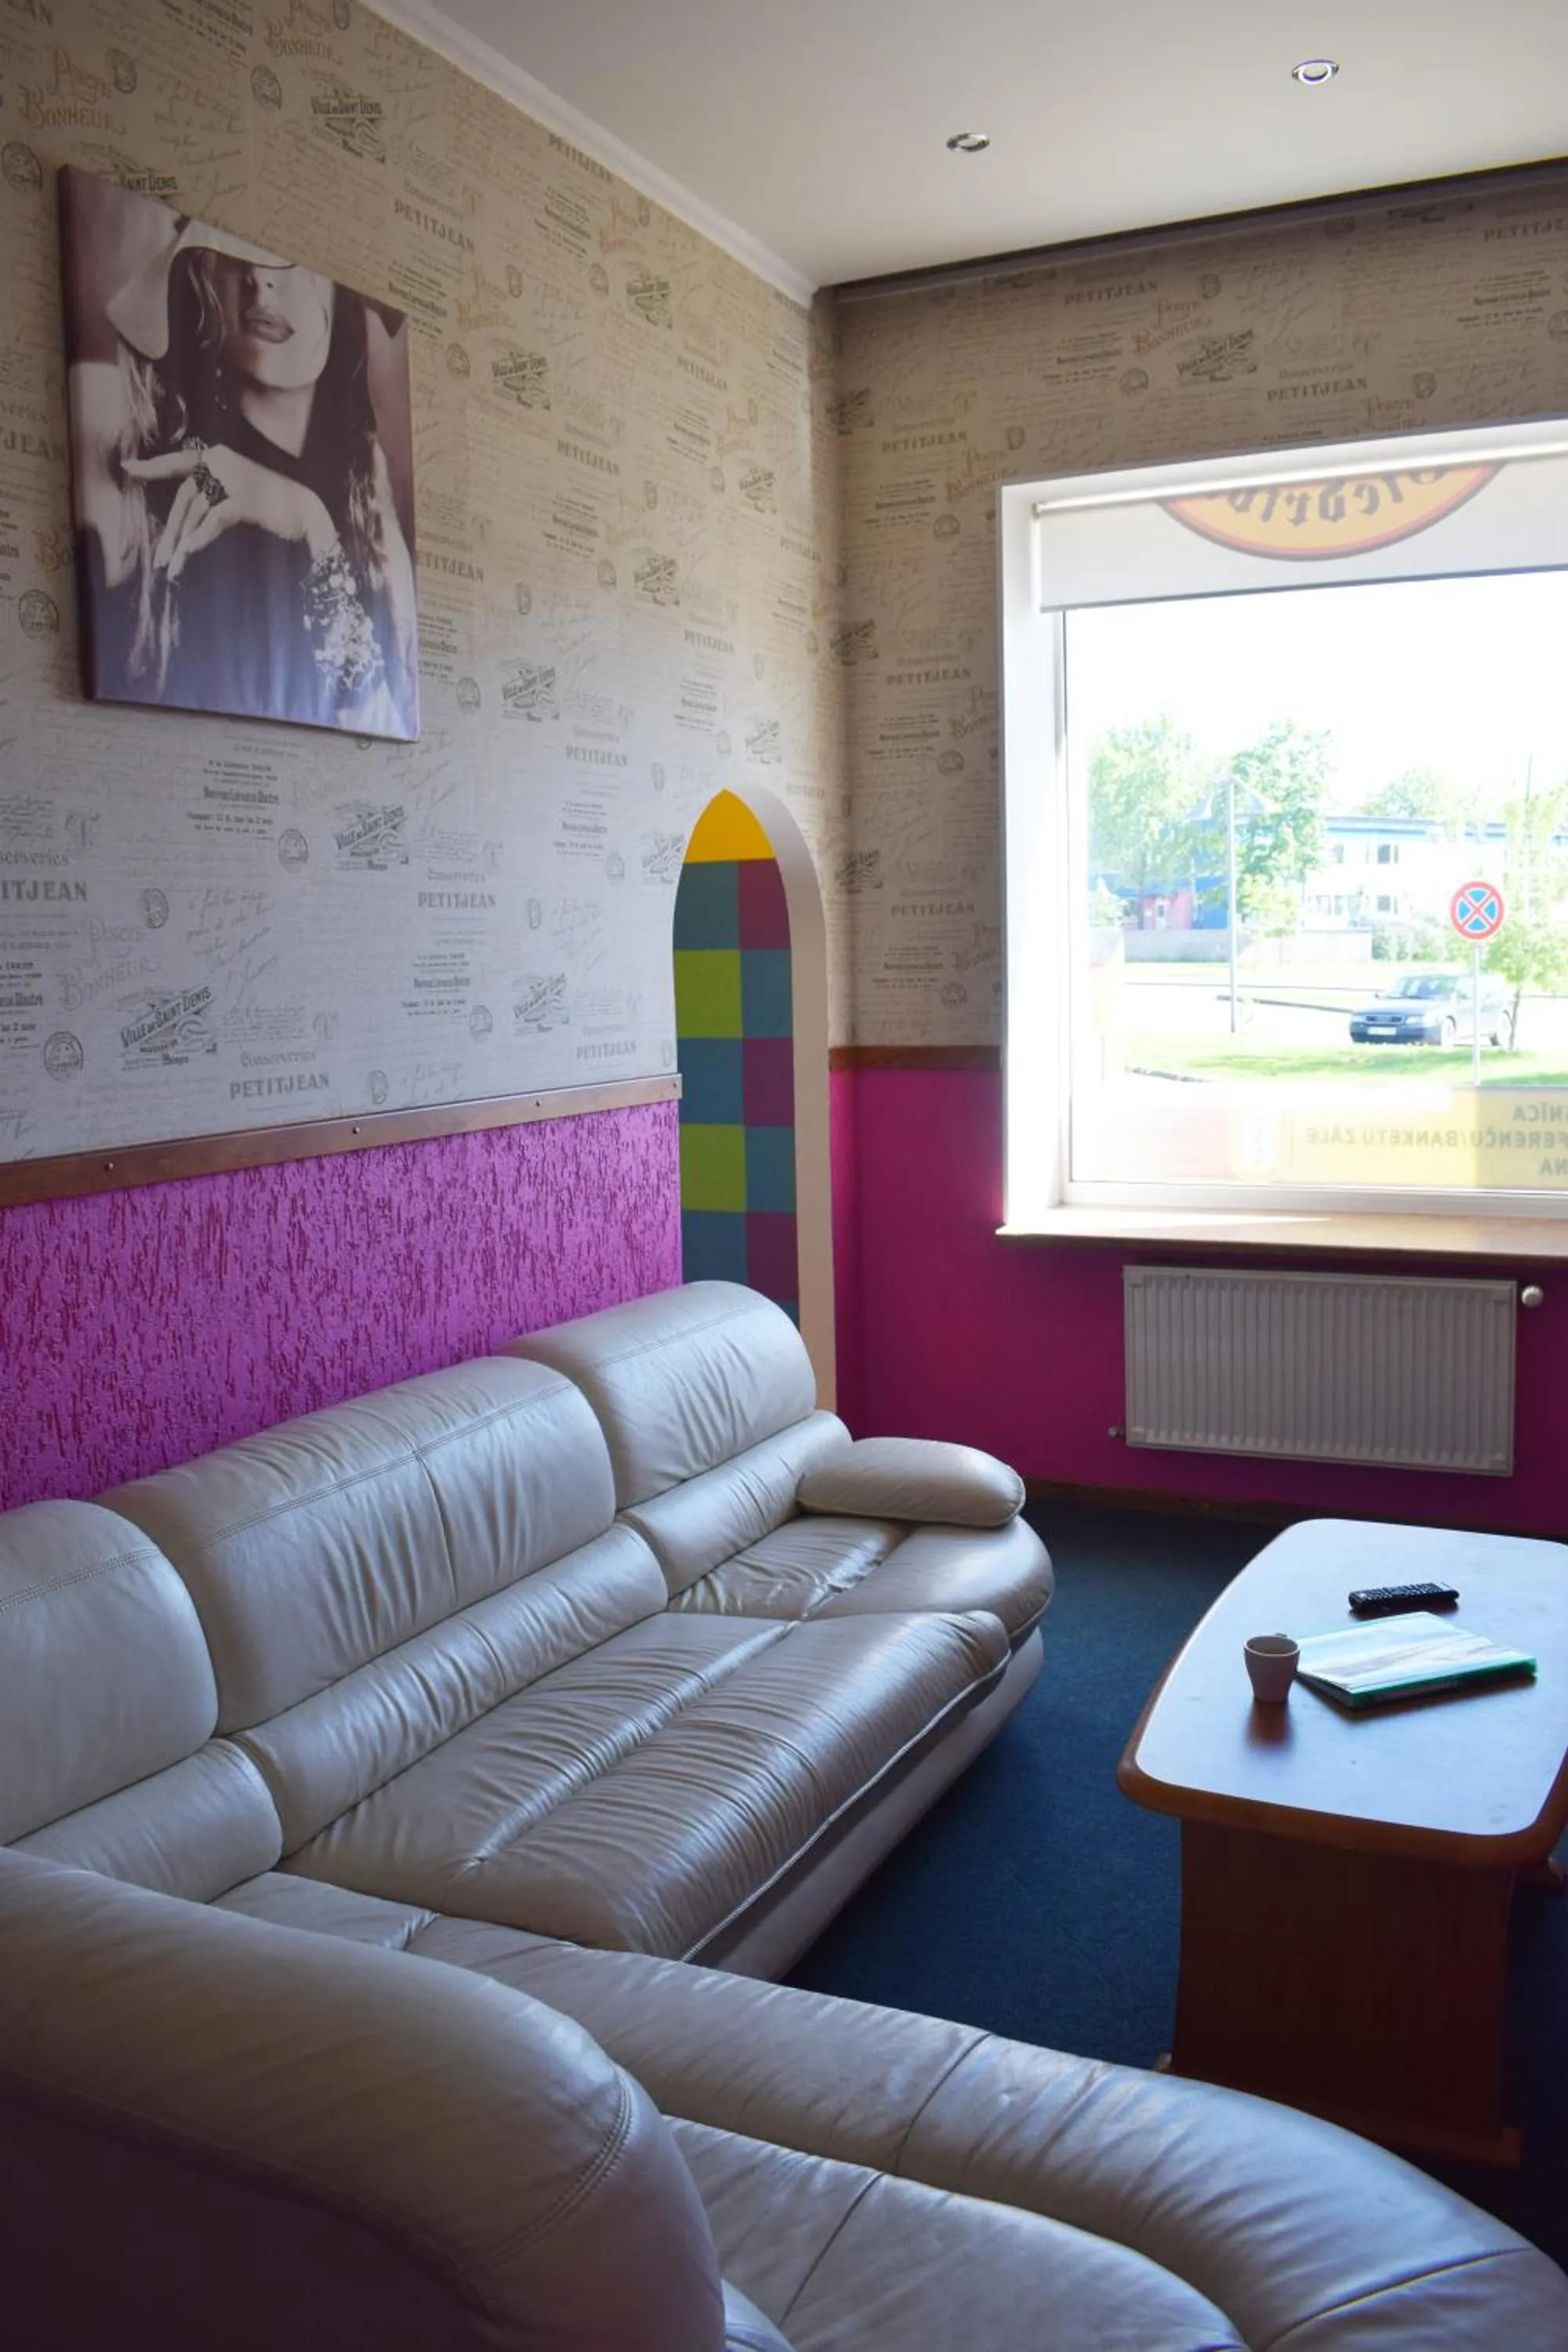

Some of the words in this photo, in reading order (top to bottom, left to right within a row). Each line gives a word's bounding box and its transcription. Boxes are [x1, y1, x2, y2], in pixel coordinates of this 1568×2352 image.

[394, 198, 475, 255] PETITJEAN
[1266, 377, 1367, 401] PETITJEAN
[886, 667, 971, 686] PETITJEAN
[418, 891, 496, 909] PETITJEAN
[891, 902, 975, 916] PETITJEAN
[229, 1070, 330, 1100] PETITJEAN
